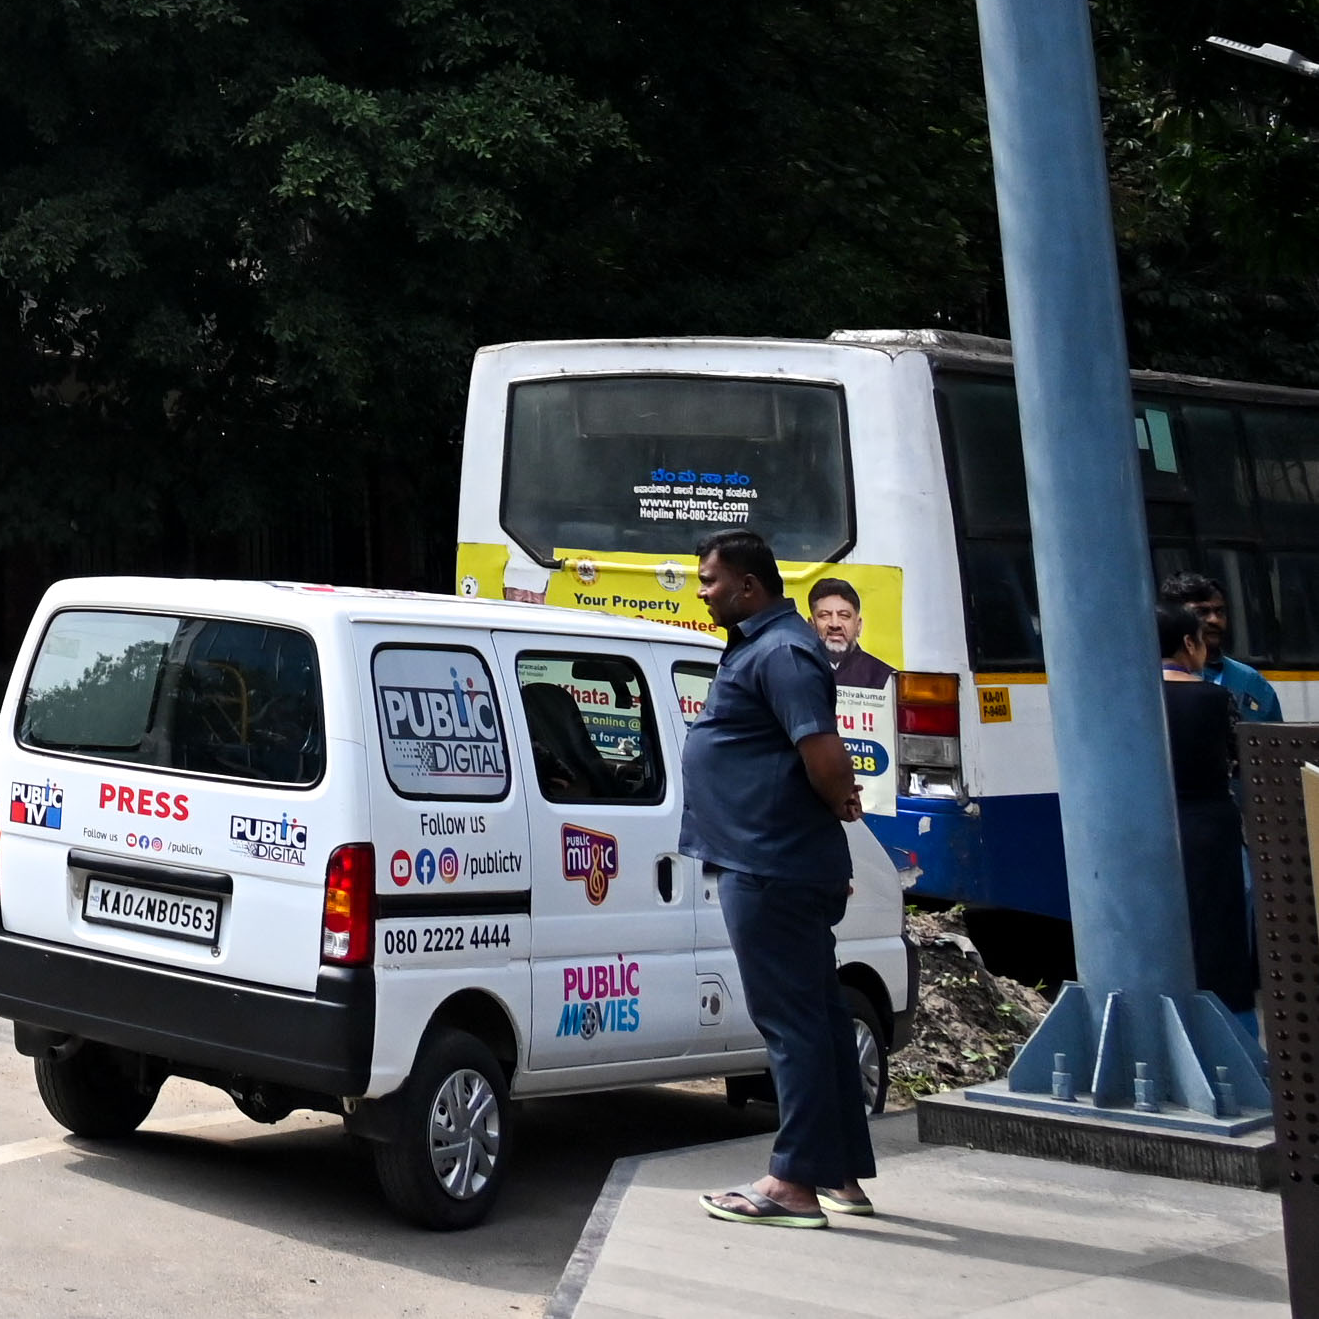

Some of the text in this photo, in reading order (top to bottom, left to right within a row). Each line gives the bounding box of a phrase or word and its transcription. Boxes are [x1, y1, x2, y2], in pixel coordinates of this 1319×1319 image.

[640, 498, 749, 511] www.mybmtc.com
[640, 507, 674, 521] Helpline
[465, 585, 472, 594] 2
[574, 593, 680, 613] Your Property
[837, 689, 886, 701] Shivakumar
[592, 715, 626, 728] online
[600, 732, 615, 743] for
[433, 742, 503, 774] DIGITAL
[99, 782, 190, 822] PRESS
[25, 802, 47, 825] TV
[420, 812, 486, 836] Follow us
[83, 828, 203, 856] Follow us /publictv
[257, 843, 306, 864] DIGITAL
[463, 849, 522, 880] /publictv
[100, 888, 215, 932] KA04NB0563
[384, 924, 511, 955] 080 2222 4444
